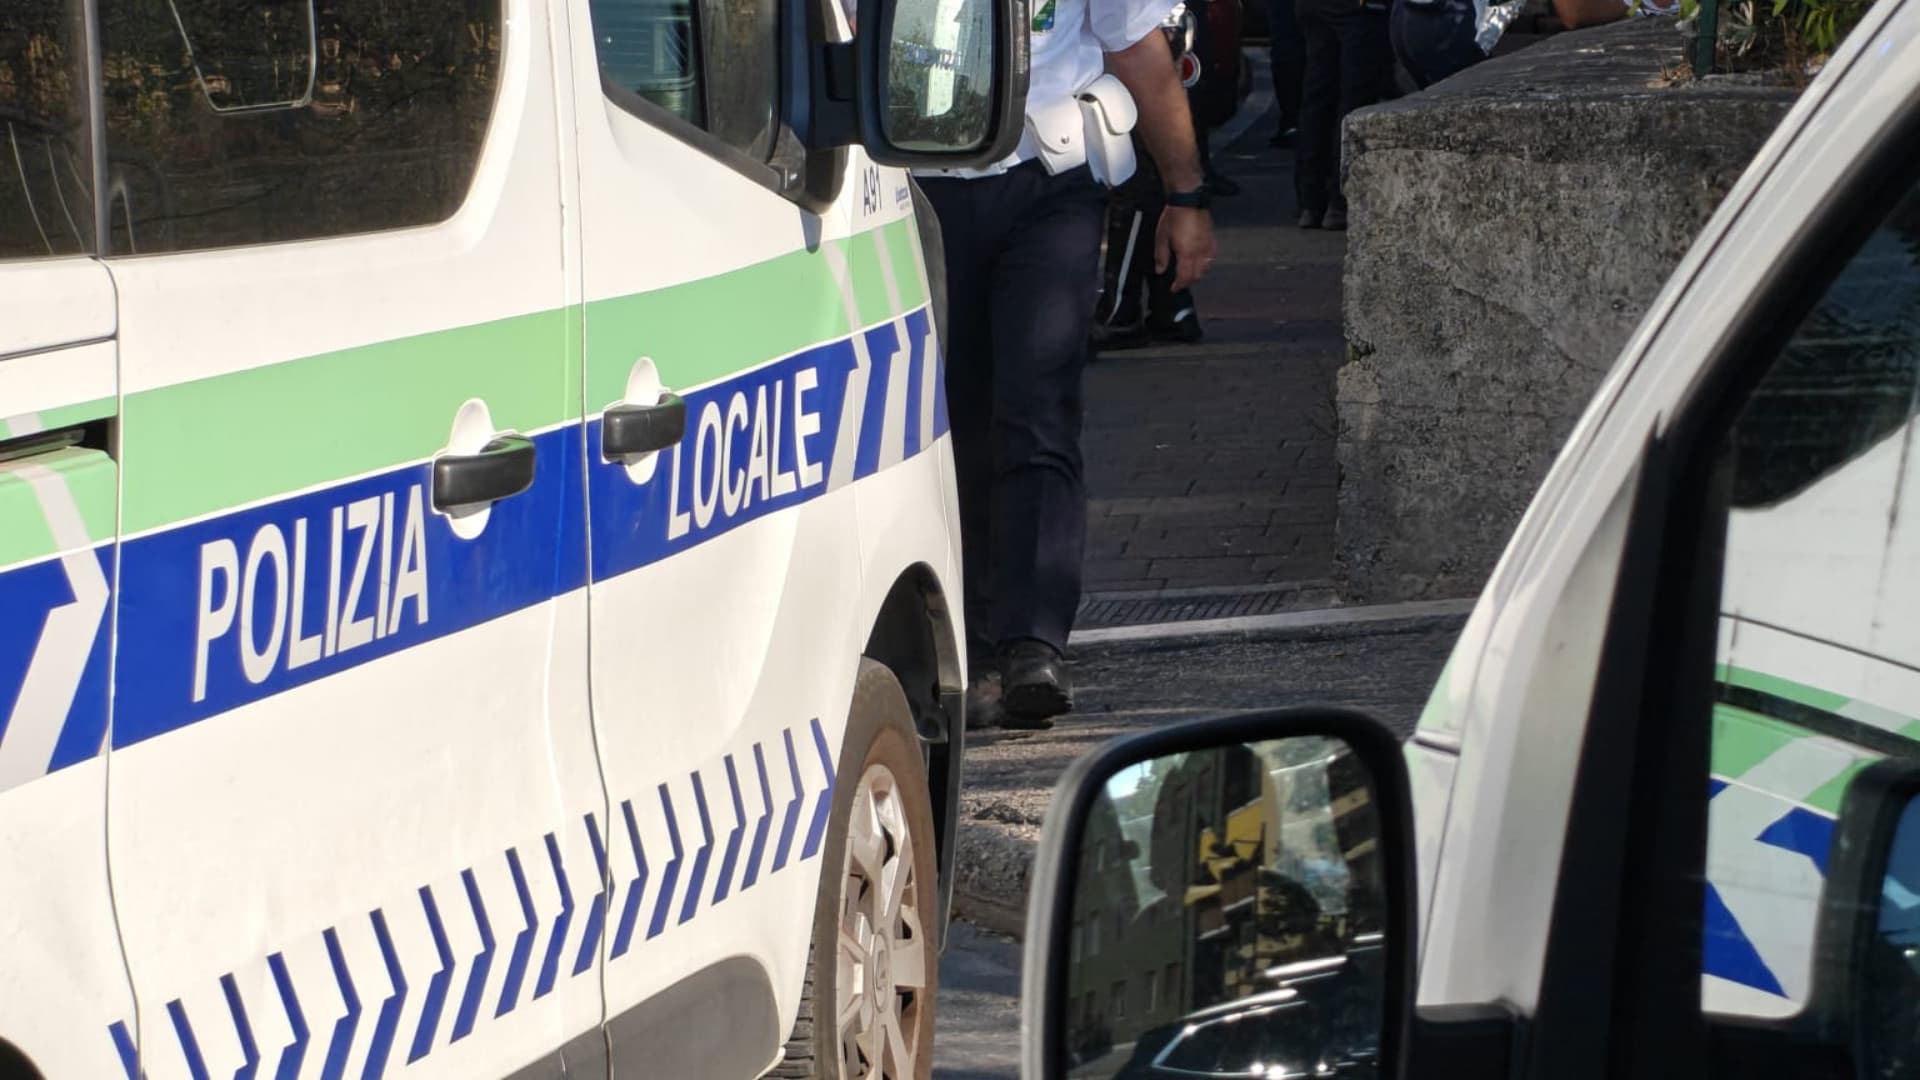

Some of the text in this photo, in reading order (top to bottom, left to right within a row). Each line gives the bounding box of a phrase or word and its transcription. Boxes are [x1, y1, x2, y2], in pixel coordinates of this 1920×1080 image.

[863, 164, 882, 217] A91
[192, 367, 824, 703] POLIZIA LOCALE
